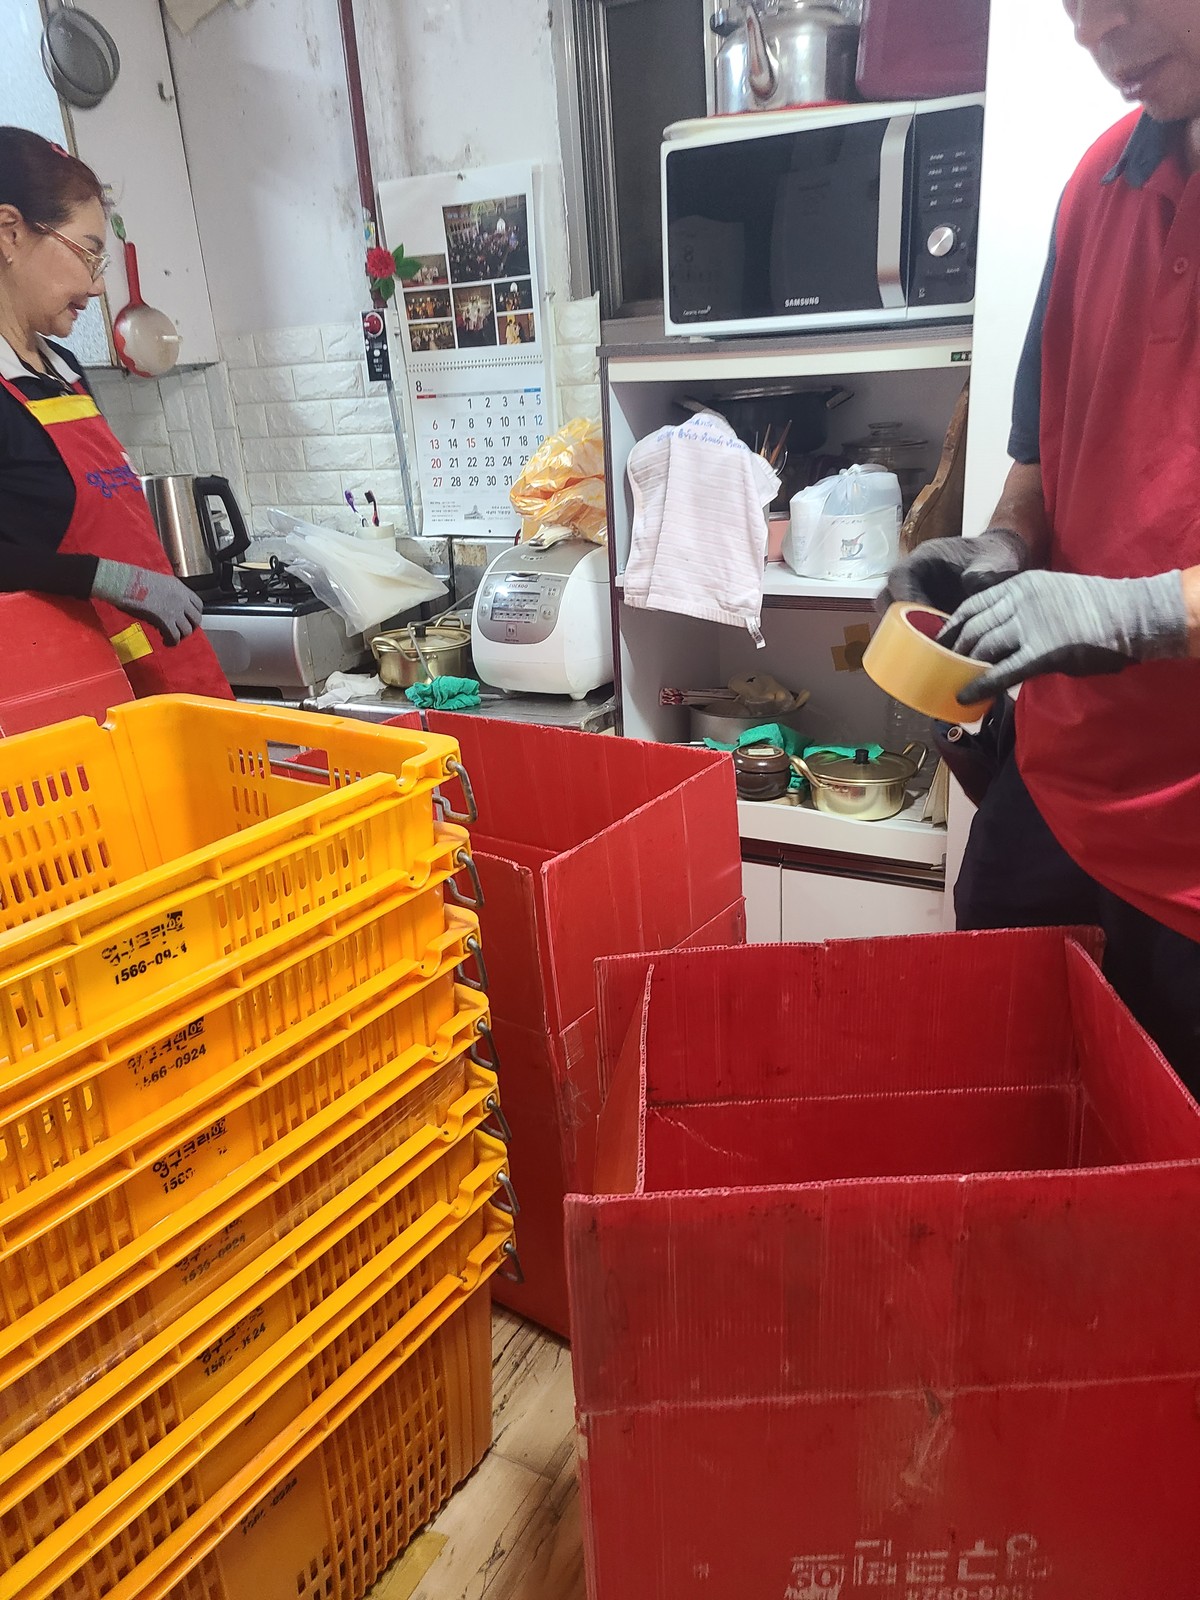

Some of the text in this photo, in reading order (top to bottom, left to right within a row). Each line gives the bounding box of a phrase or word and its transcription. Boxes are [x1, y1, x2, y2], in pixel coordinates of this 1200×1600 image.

[784, 296, 820, 308] SAMSUNG
[415, 380, 422, 392] 8
[467, 395, 541, 409] 1 2 3 4 5
[432, 415, 543, 430] 6 7 8 9 10 11 12
[430, 439, 440, 450] 13
[448, 438, 458, 449] 14
[466, 438, 476, 448] 15
[484, 437, 494, 448] 16
[501, 436, 511, 447] 17
[519, 435, 528, 446] 18
[431, 455, 529, 469] 20 21 22 23 24 25
[432, 475, 513, 487] 27 28 29 30 31
